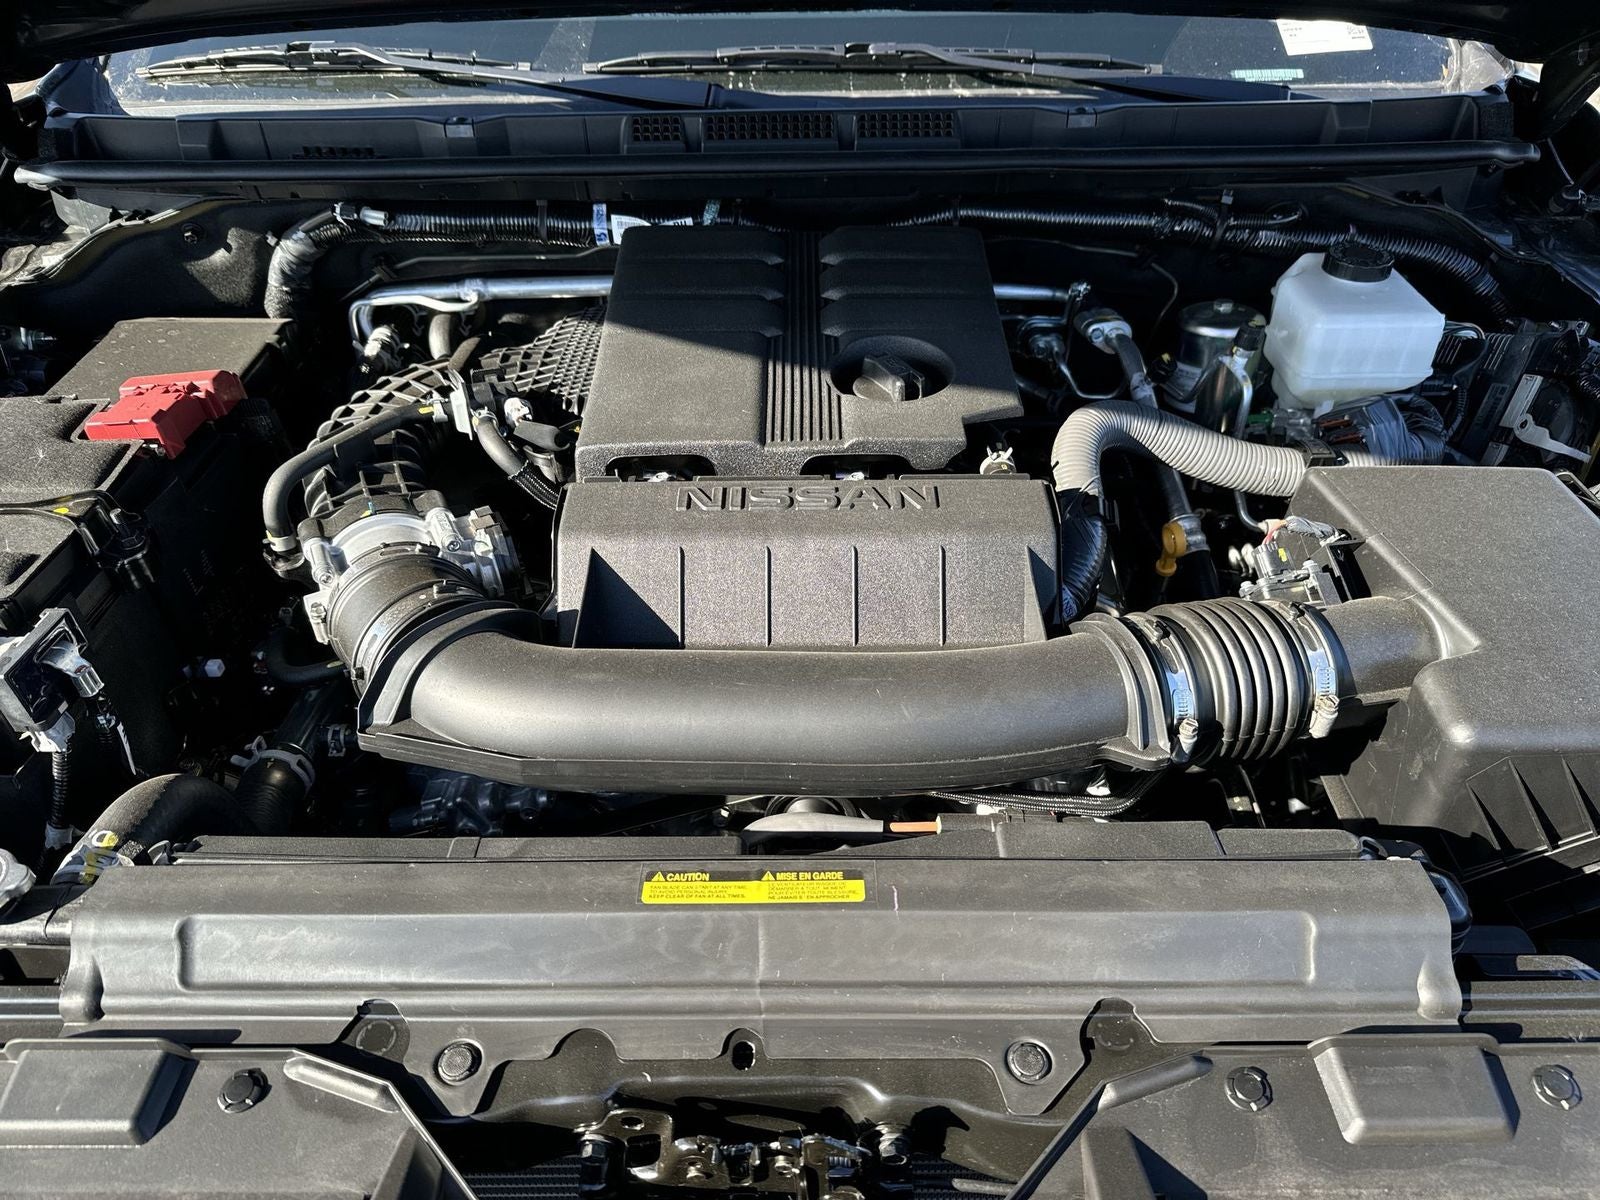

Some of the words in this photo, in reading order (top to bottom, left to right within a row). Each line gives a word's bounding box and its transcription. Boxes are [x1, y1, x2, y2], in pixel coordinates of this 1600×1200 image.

[676, 486, 940, 511] NISSAN
[666, 872, 710, 882] CAUTION
[776, 872, 798, 881] MISE
[799, 872, 811, 881] EN
[813, 871, 844, 881] GARDE
